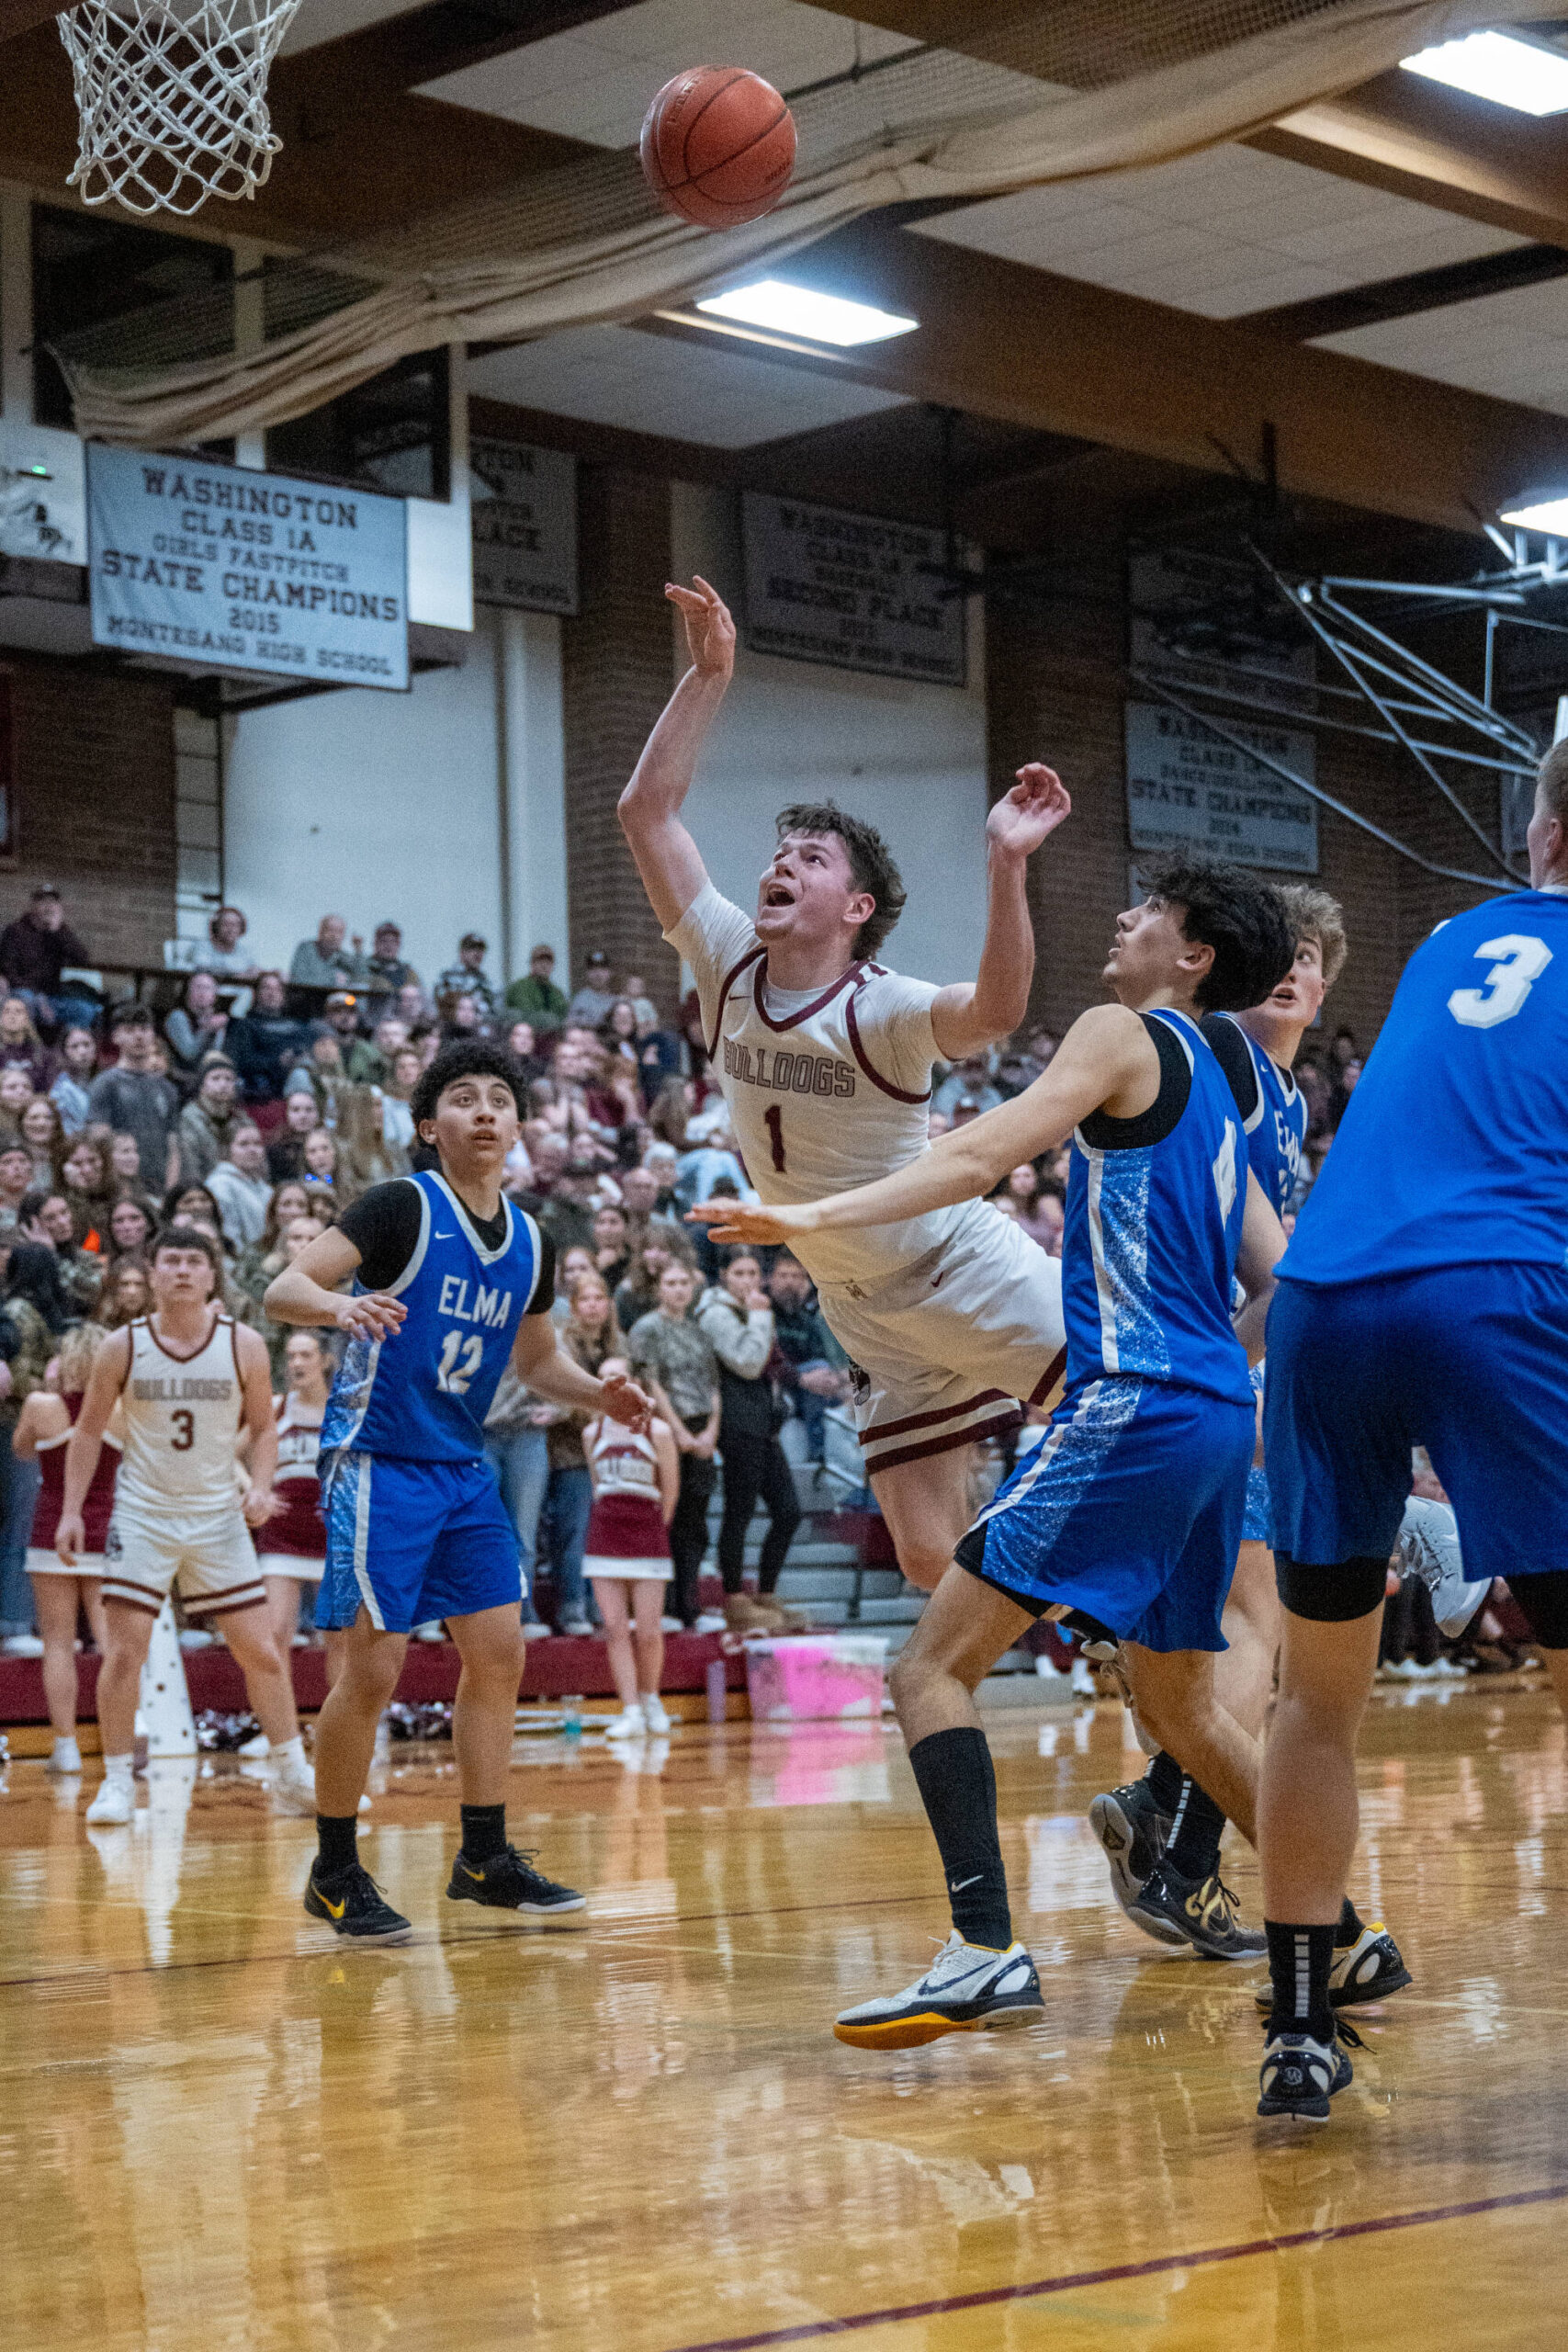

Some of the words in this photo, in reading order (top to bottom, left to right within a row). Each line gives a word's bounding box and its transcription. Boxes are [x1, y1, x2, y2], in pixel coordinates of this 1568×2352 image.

[142, 467, 357, 529] WASHINGTON
[181, 509, 274, 546] CLASS
[102, 548, 205, 594] STATE
[221, 571, 399, 622] CHAMPIONS
[152, 533, 219, 562] GIRLS
[229, 547, 348, 582] FASTPITCH
[107, 615, 245, 654] MONTESANO
[256, 639, 307, 664] HIGH
[317, 648, 393, 675] SCHOOL
[229, 606, 281, 635] 2015
[1132, 776, 1196, 808] STATE
[1447, 933, 1554, 1029] 3
[723, 1036, 855, 1098] BULLDOGS
[764, 1105, 786, 1173] 1
[437, 1274, 512, 1329] ELMA
[134, 1379, 231, 1402] BULLDOGS
[436, 1329, 483, 1396] 12
[171, 1408, 195, 1451] 3
